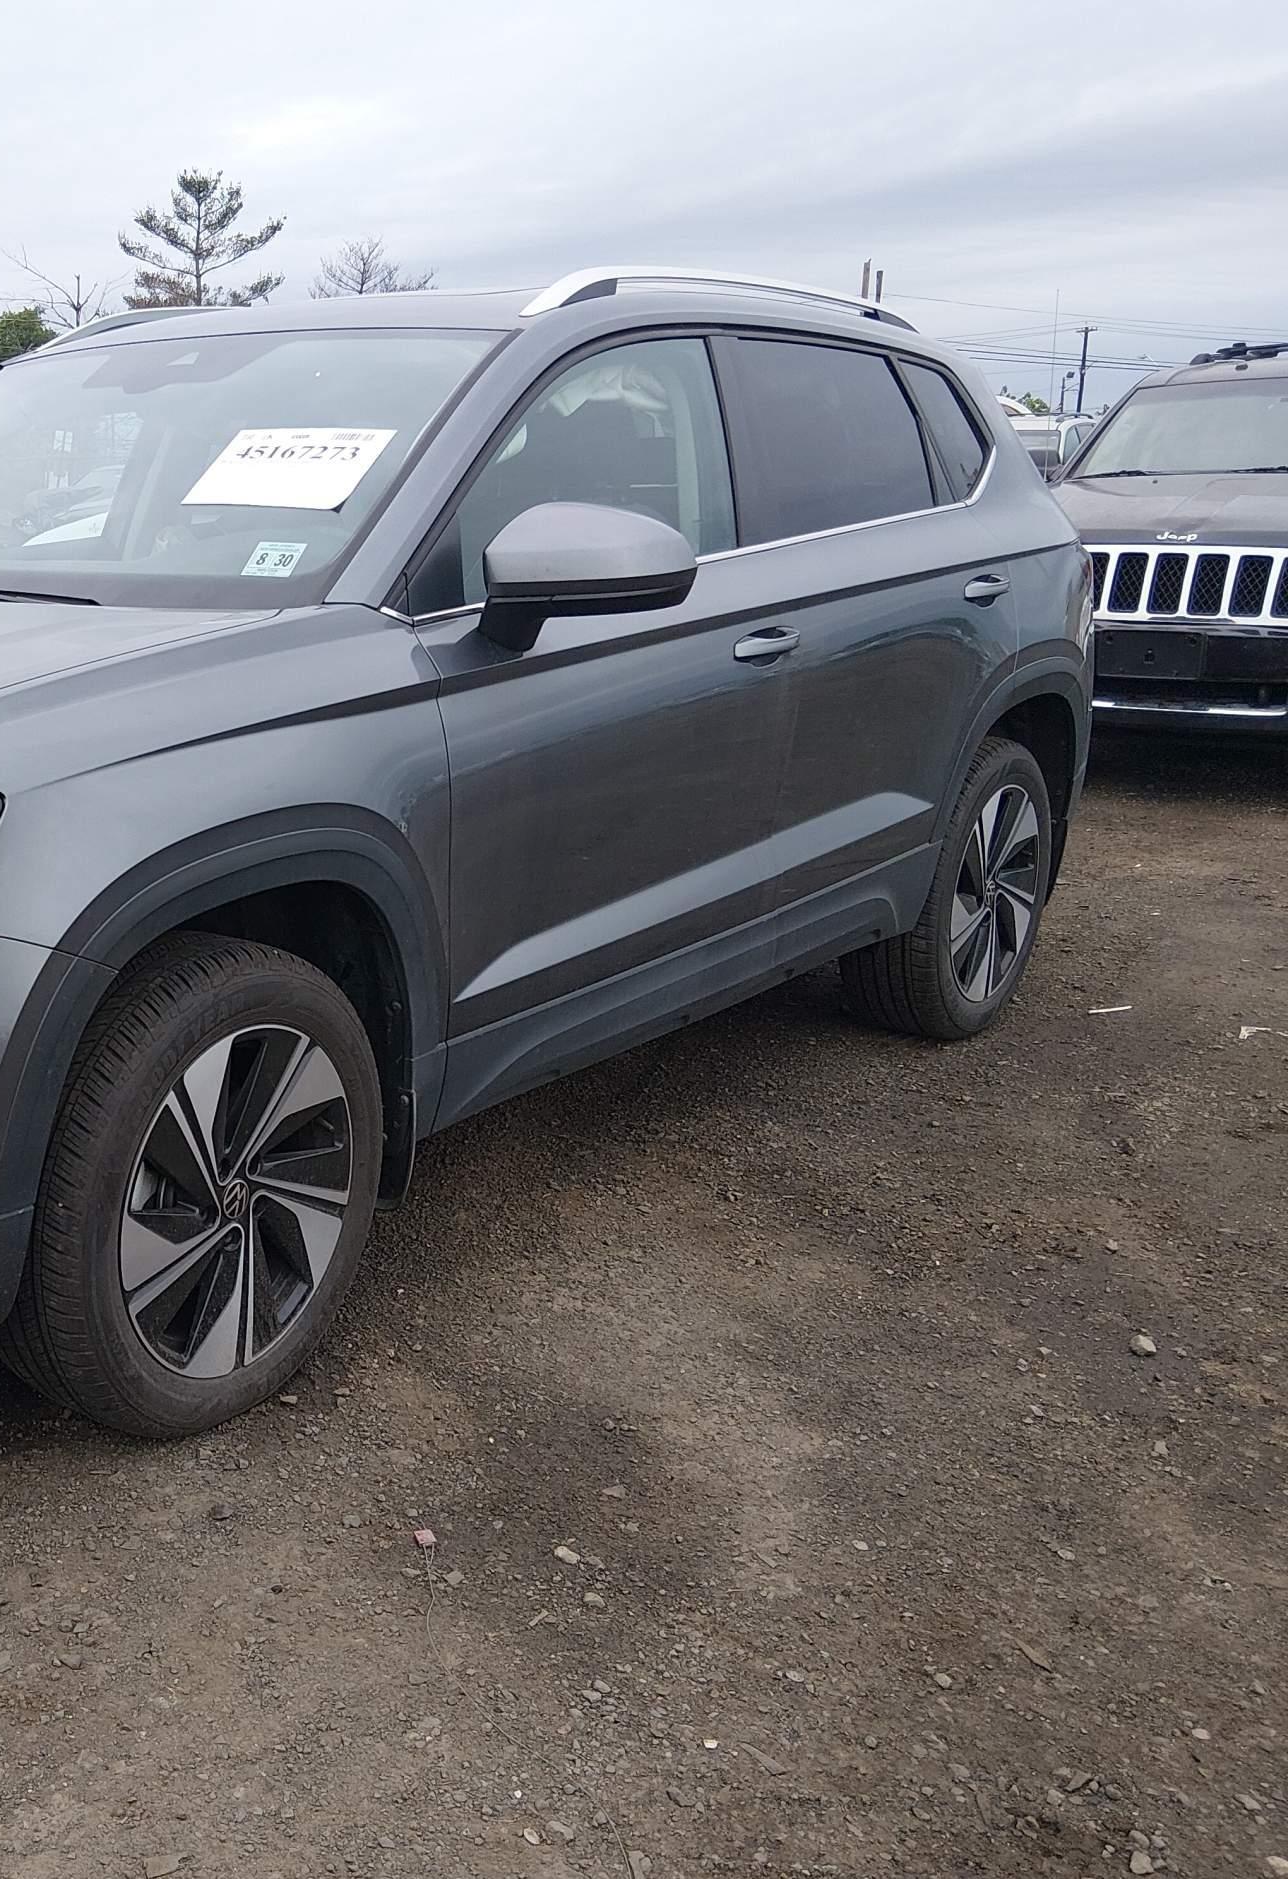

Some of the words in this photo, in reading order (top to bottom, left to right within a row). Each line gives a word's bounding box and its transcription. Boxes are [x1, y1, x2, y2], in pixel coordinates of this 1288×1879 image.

[237, 445, 361, 460] 45167273
[255, 552, 269, 566] 8
[273, 553, 295, 568] 30
